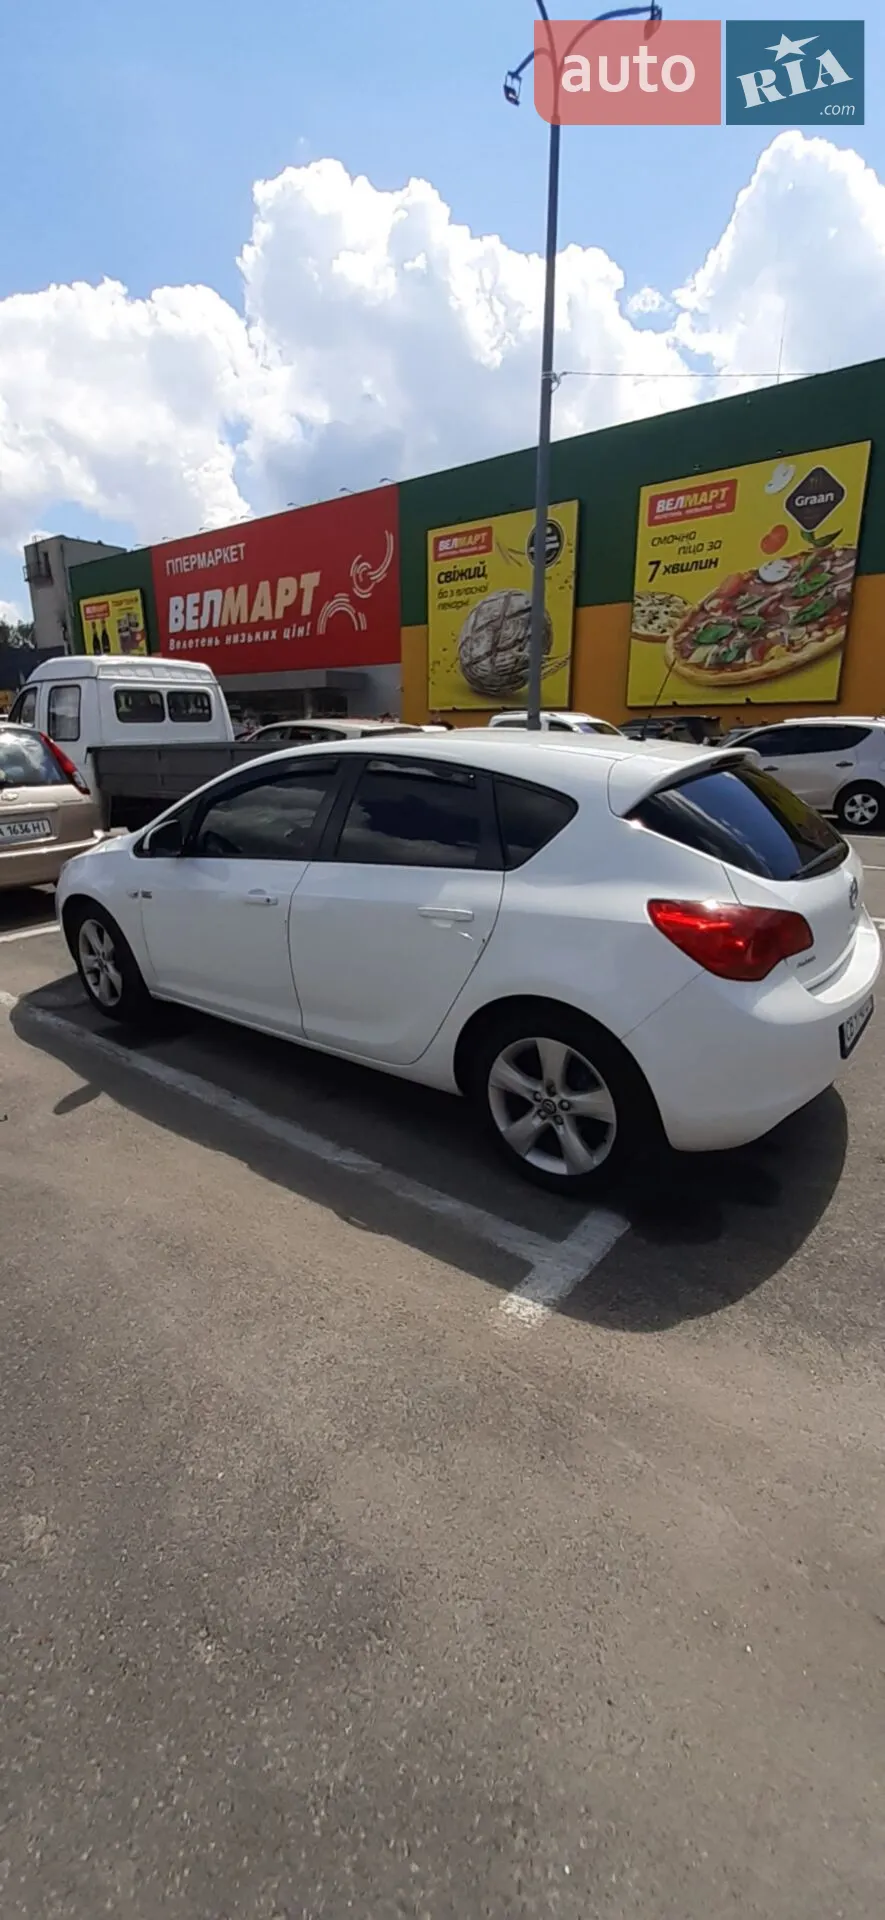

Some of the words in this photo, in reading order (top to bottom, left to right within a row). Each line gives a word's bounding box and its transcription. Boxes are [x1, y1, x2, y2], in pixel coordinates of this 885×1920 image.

[656, 486, 730, 514] ВЕЛМАРТ
[794, 492, 835, 507] Graan
[438, 532, 489, 552] ВЕЛМАРТ
[165, 542, 246, 576] ГІПЕРМАРКЕТ
[648, 559, 662, 583] 7
[662, 557, 720, 576] хвилин
[168, 570, 322, 634] ВЕЛМАРТ
[169, 635, 221, 651] Велетень
[225, 628, 278, 645] низьких
[282, 621, 312, 641] цін!
